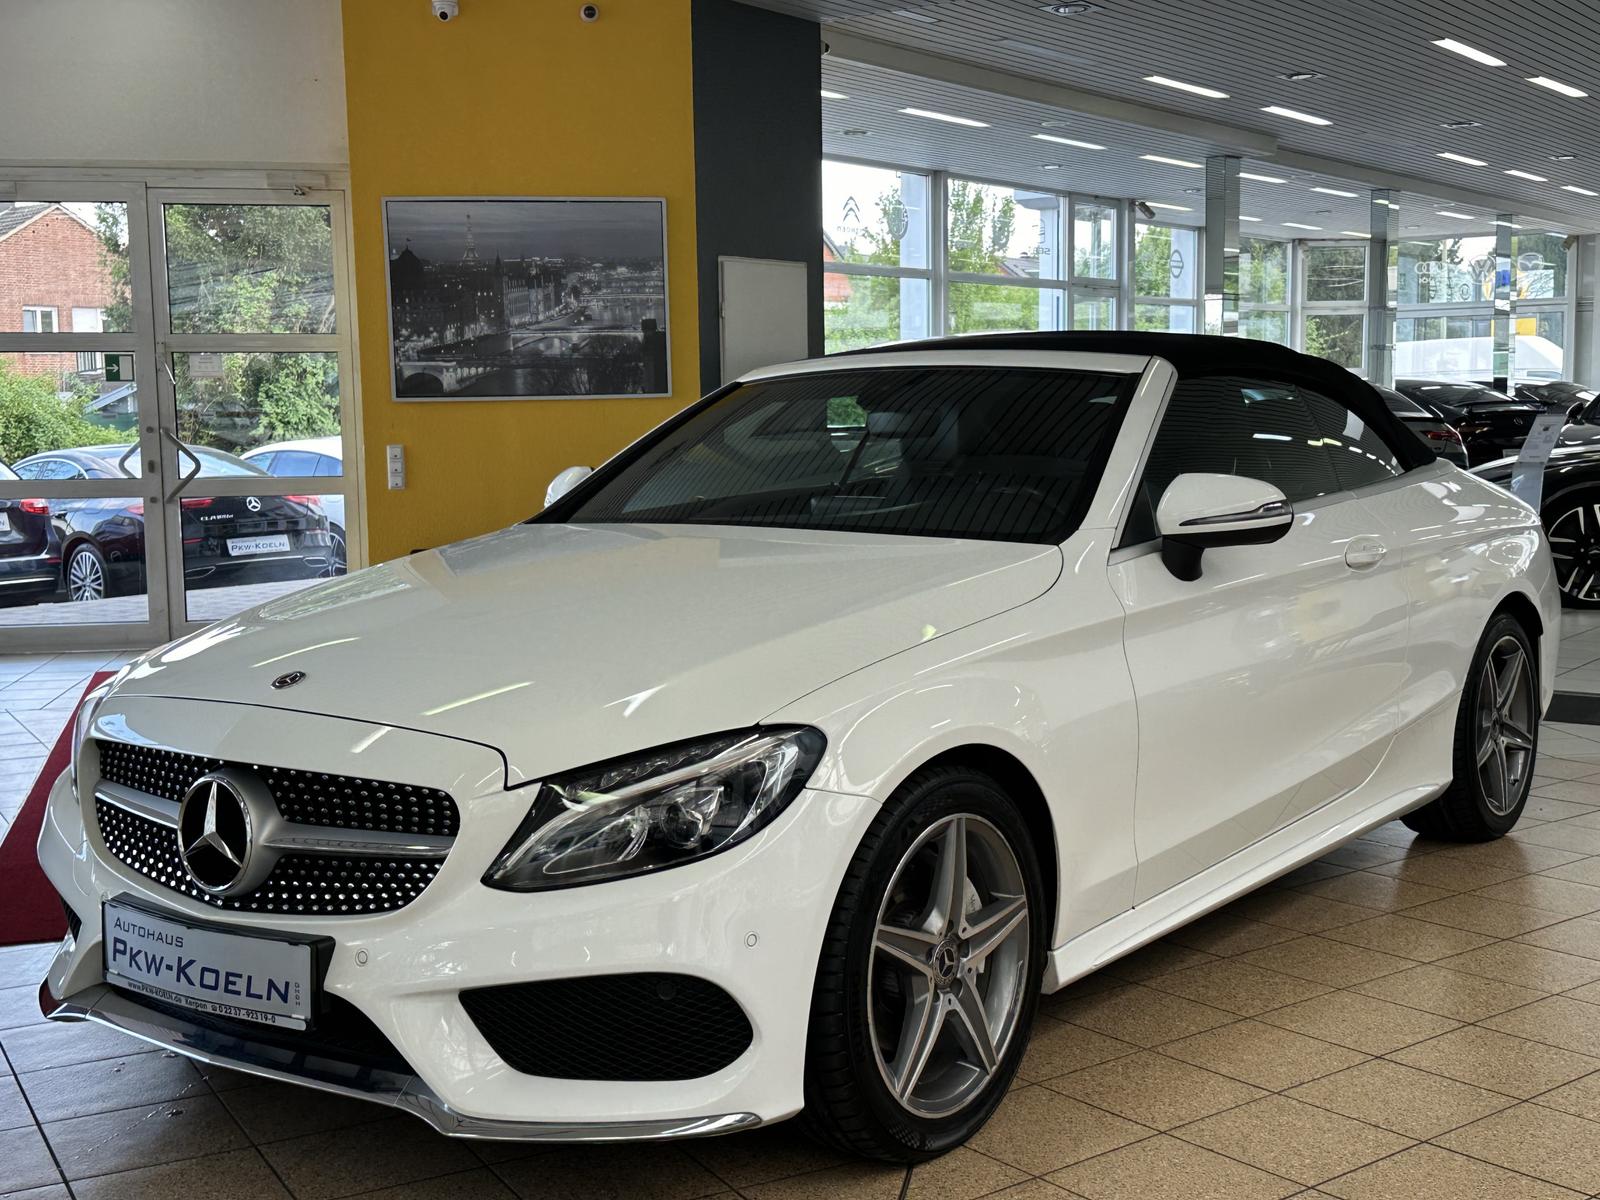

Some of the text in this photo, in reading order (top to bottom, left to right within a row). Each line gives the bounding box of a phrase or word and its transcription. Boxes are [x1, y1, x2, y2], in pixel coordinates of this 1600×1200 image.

[231, 541, 285, 551] PKW-KOELN
[113, 917, 184, 948] AUTOHAUS
[112, 936, 290, 1004] PKW-KOELN
